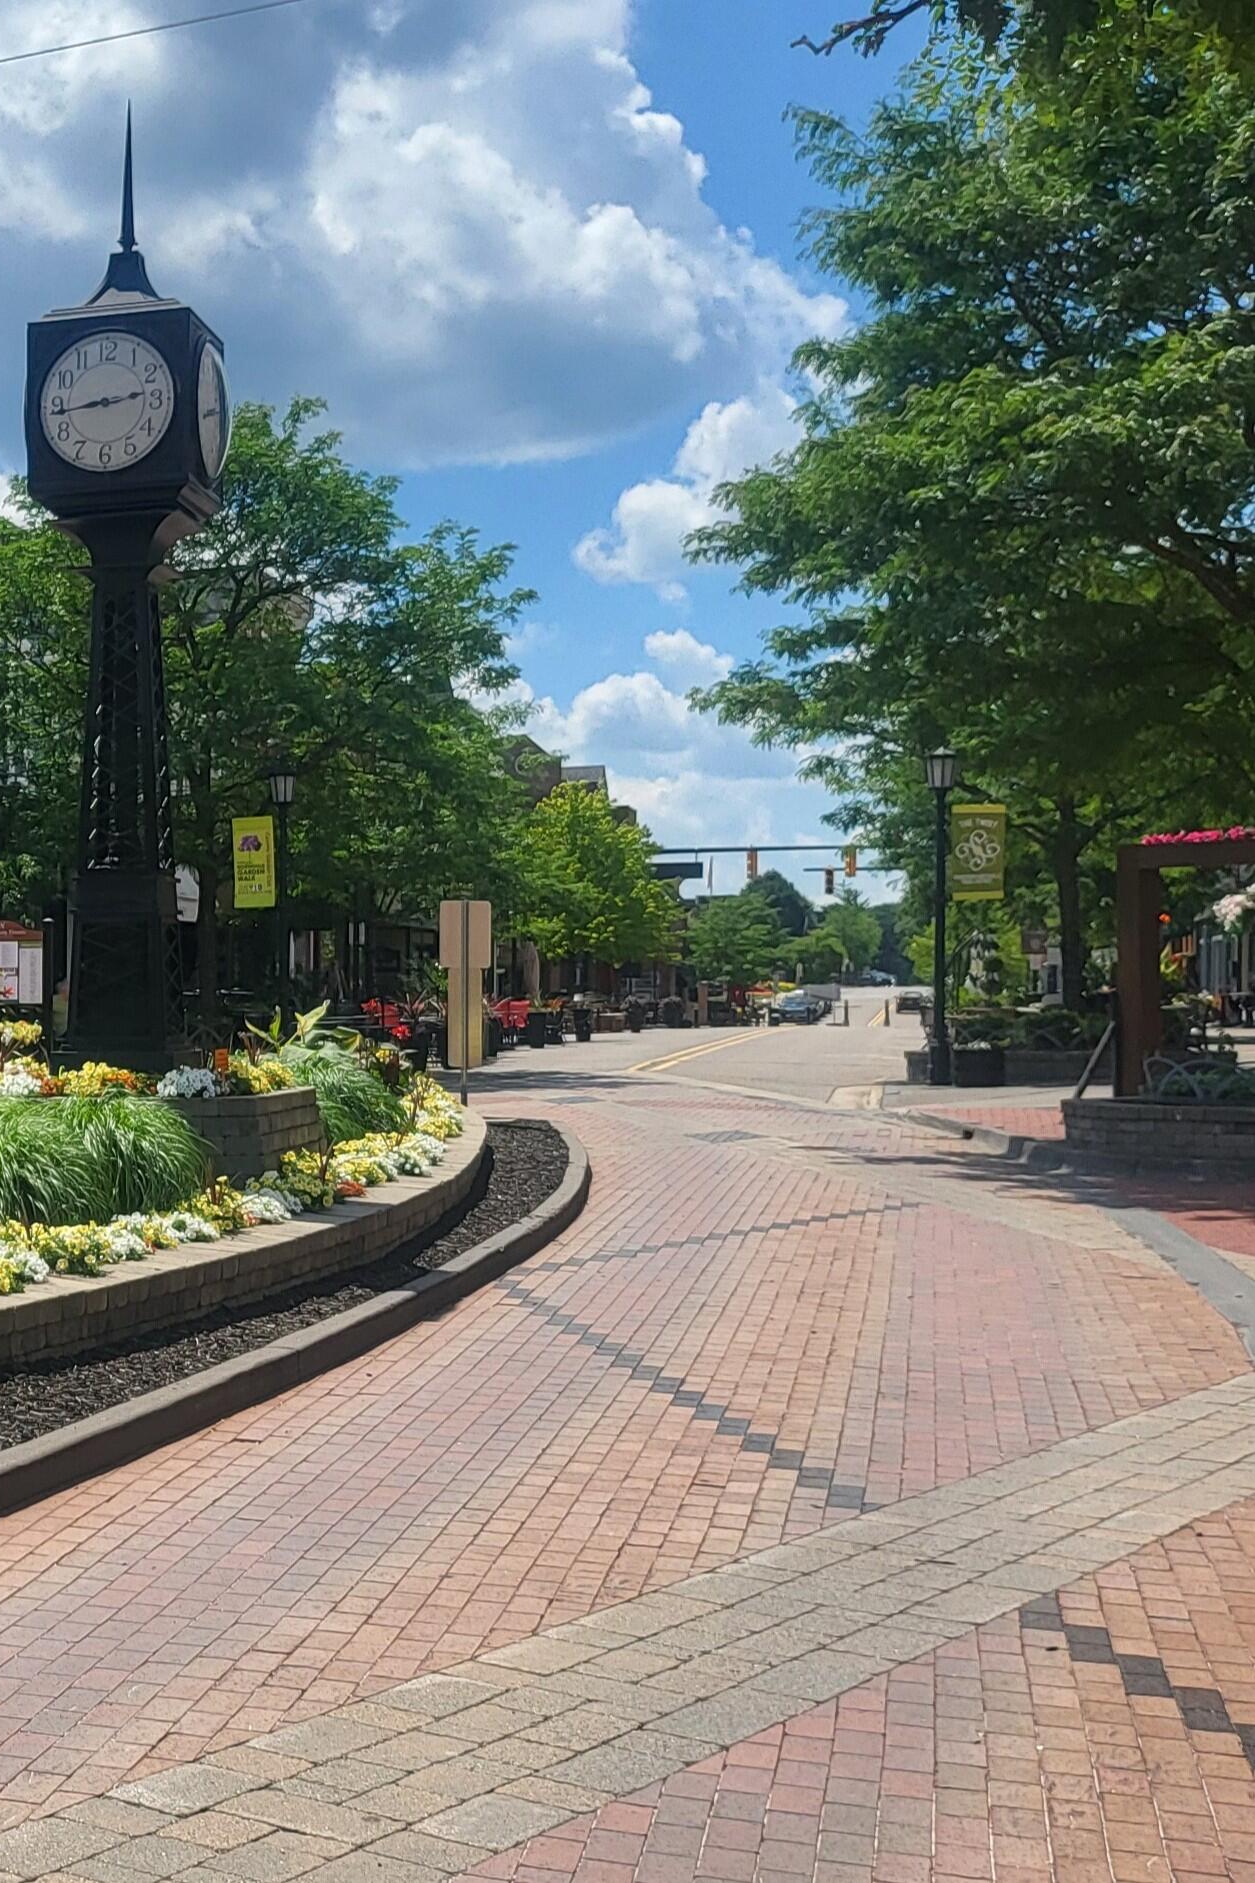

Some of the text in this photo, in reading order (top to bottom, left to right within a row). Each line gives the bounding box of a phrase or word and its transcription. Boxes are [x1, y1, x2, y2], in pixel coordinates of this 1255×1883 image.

[76, 349, 88, 370] 11
[99, 341, 118, 362] 12
[131, 347, 137, 367] 1
[57, 369, 74, 390] 10
[144, 363, 157, 383] 2
[51, 395, 64, 415] 9
[149, 389, 163, 410] 3
[57, 421, 70, 441] 8
[139, 417, 154, 437] 4
[73, 440, 87, 460] 7
[99, 444, 112, 465] 6
[123, 434, 137, 456] 5
